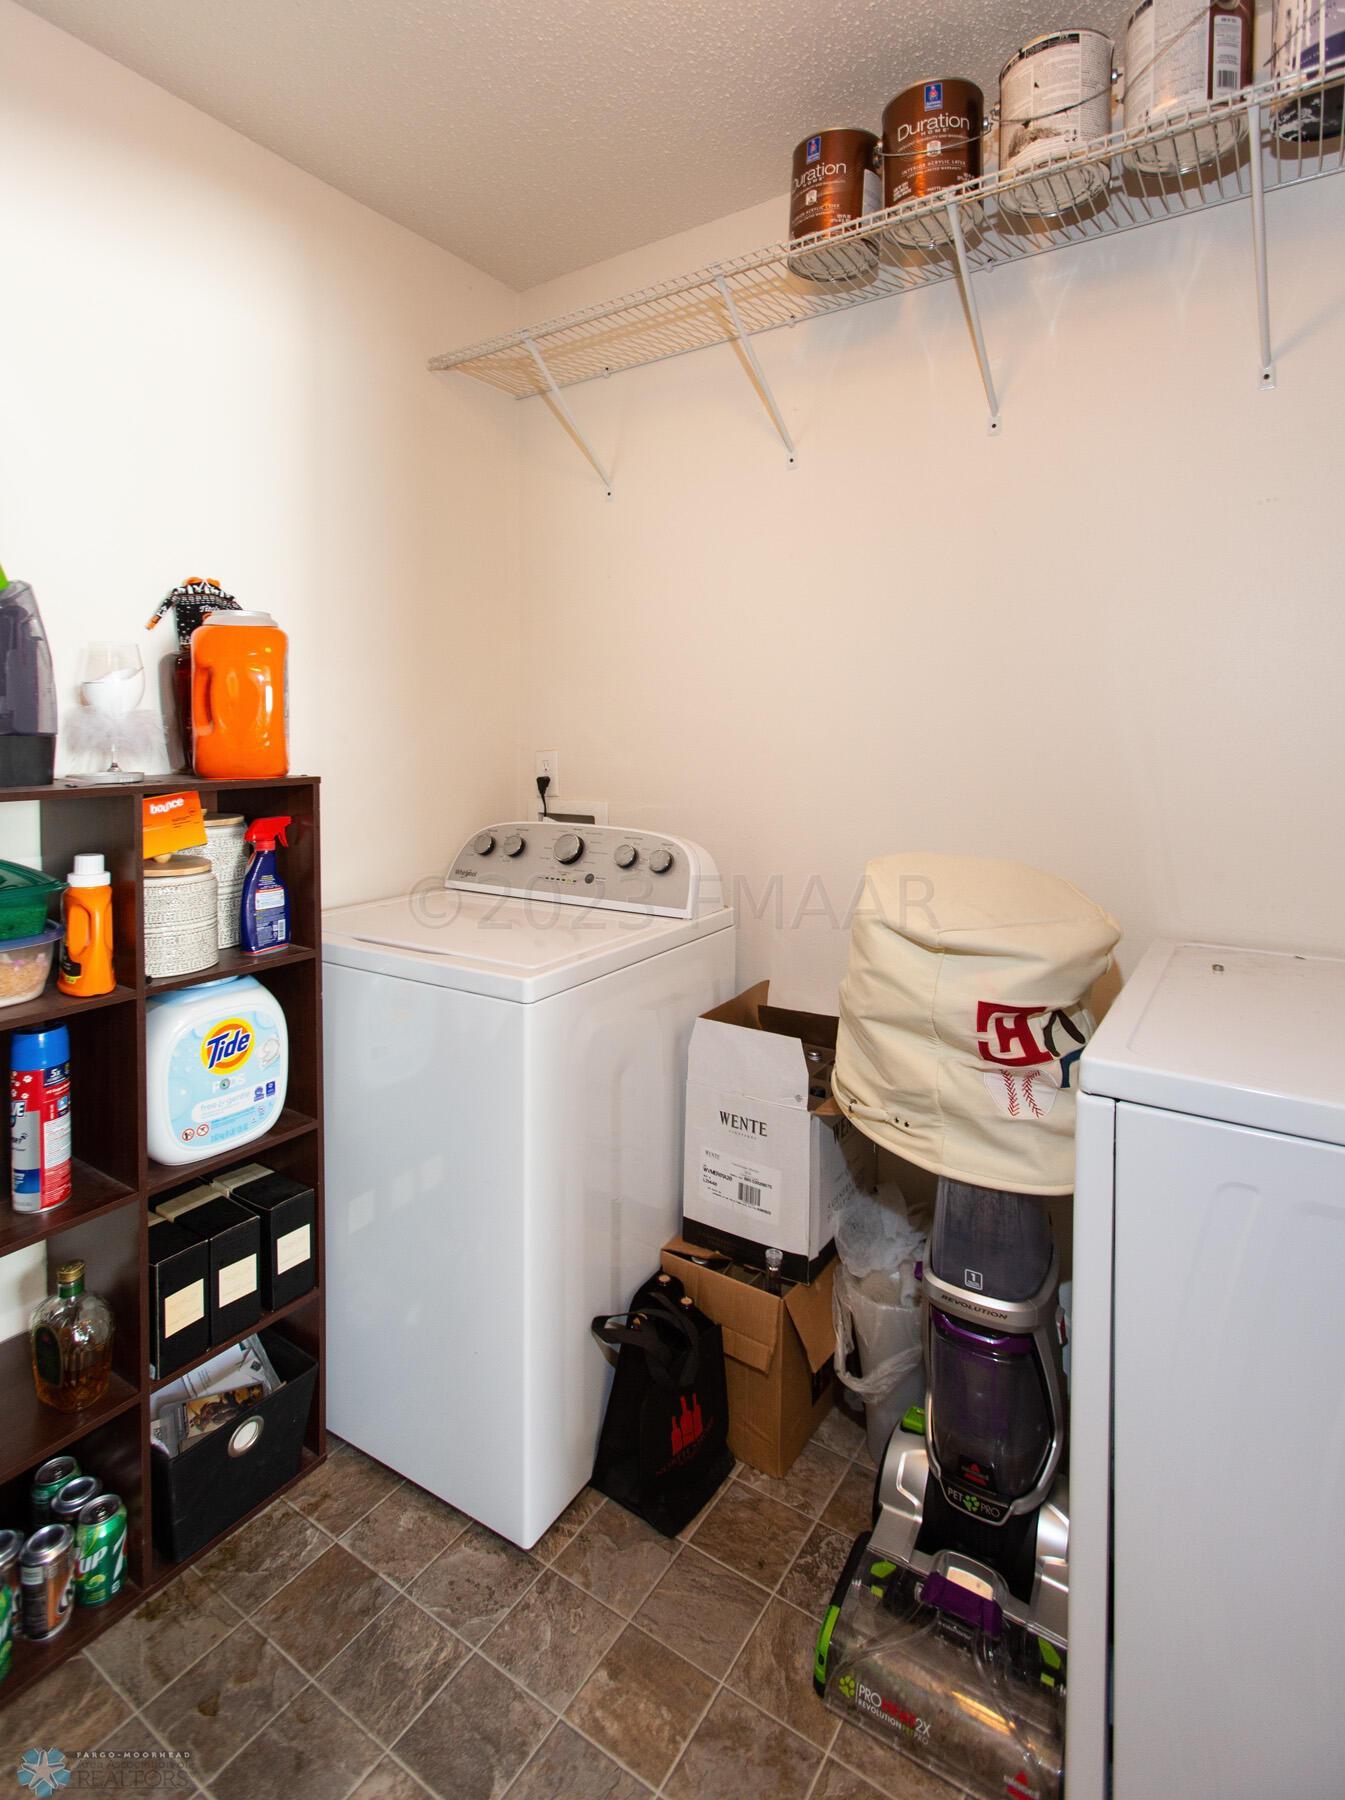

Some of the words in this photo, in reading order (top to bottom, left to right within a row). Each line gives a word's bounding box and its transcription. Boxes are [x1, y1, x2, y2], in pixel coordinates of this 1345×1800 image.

[897, 113, 970, 141] Duration
[149, 798, 185, 816] bounce
[206, 1028, 250, 1070] Tide
[719, 1110, 768, 1137] WENTE
[970, 1272, 976, 1282] 1
[941, 1294, 1008, 1320] REVOLUTION
[947, 1487, 963, 1502] PET
[980, 1504, 1001, 1518] PRO
[858, 1698, 902, 1730] REVOLUTION
